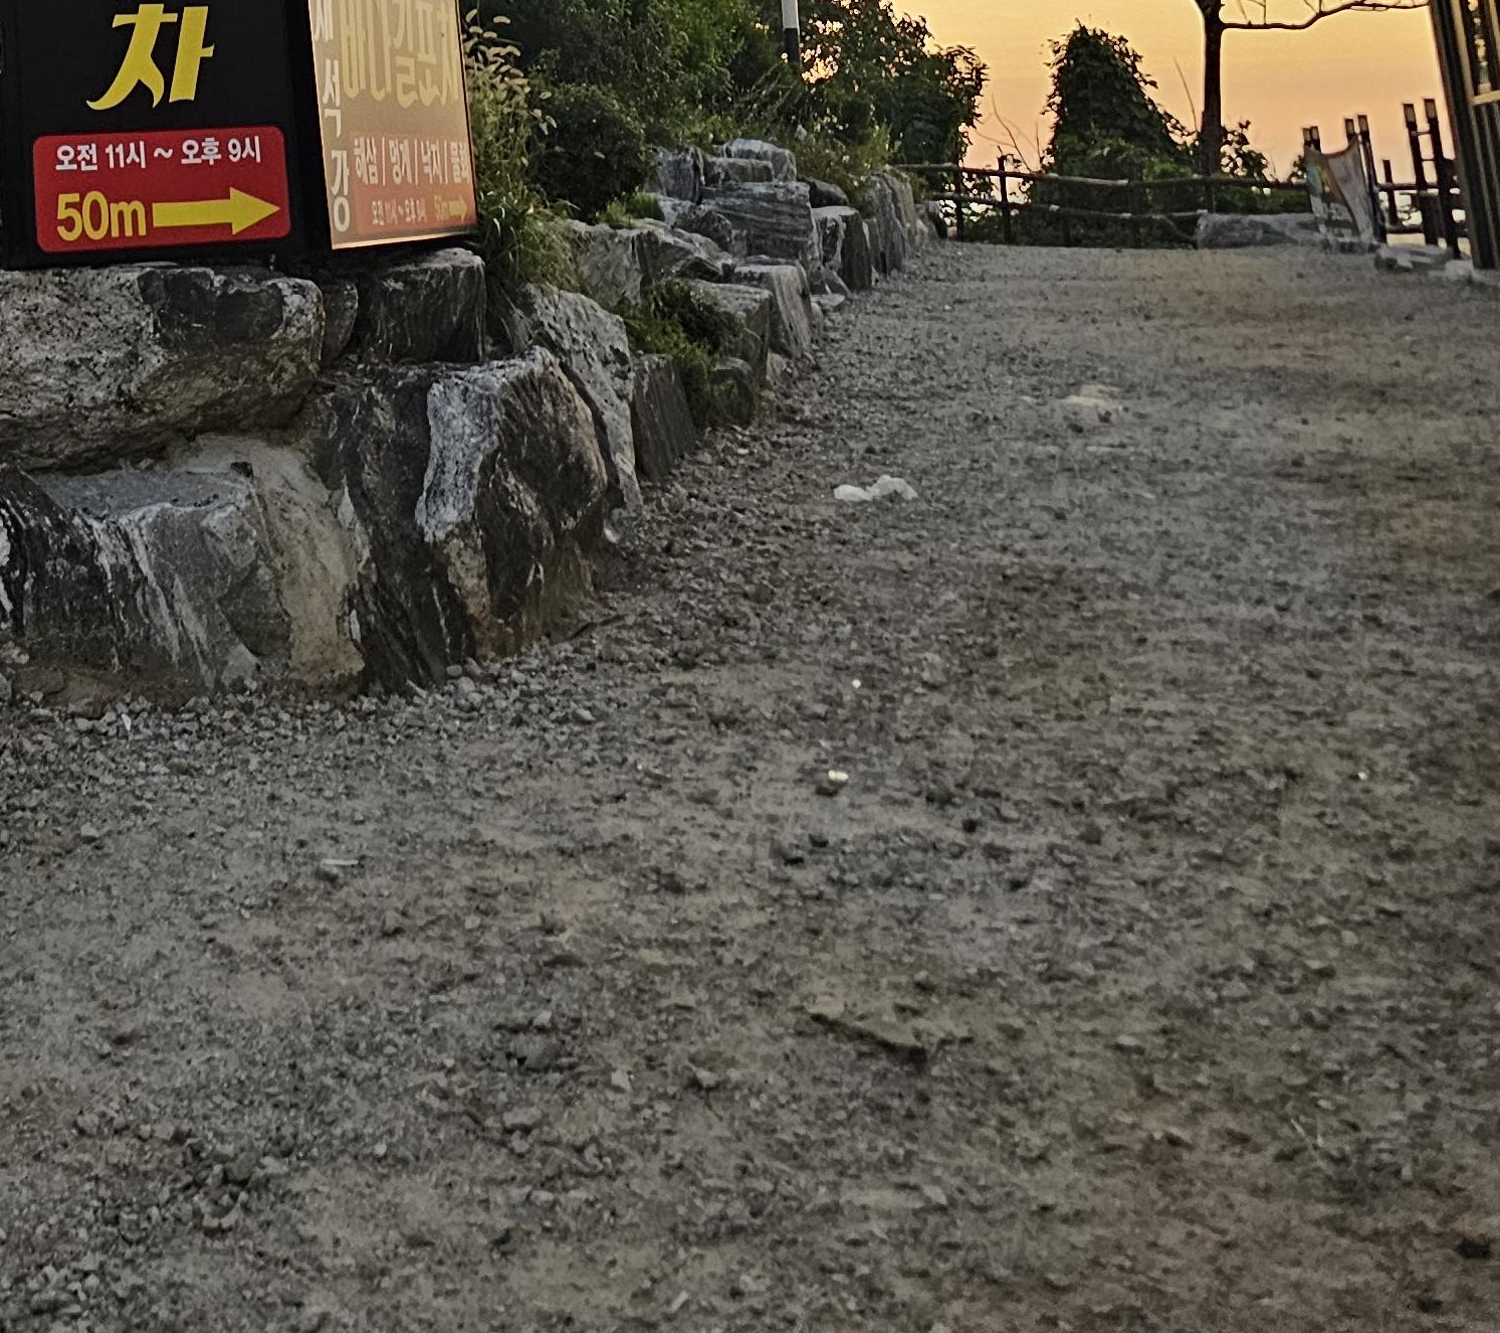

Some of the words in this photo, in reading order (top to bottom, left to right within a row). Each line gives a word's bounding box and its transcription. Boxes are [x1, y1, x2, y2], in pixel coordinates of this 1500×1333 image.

[55, 142, 99, 172] 오전
[104, 140, 147, 169] 11시
[180, 137, 222, 166] 오후
[227, 135, 262, 164] 9시
[56, 190, 148, 242] 50m
